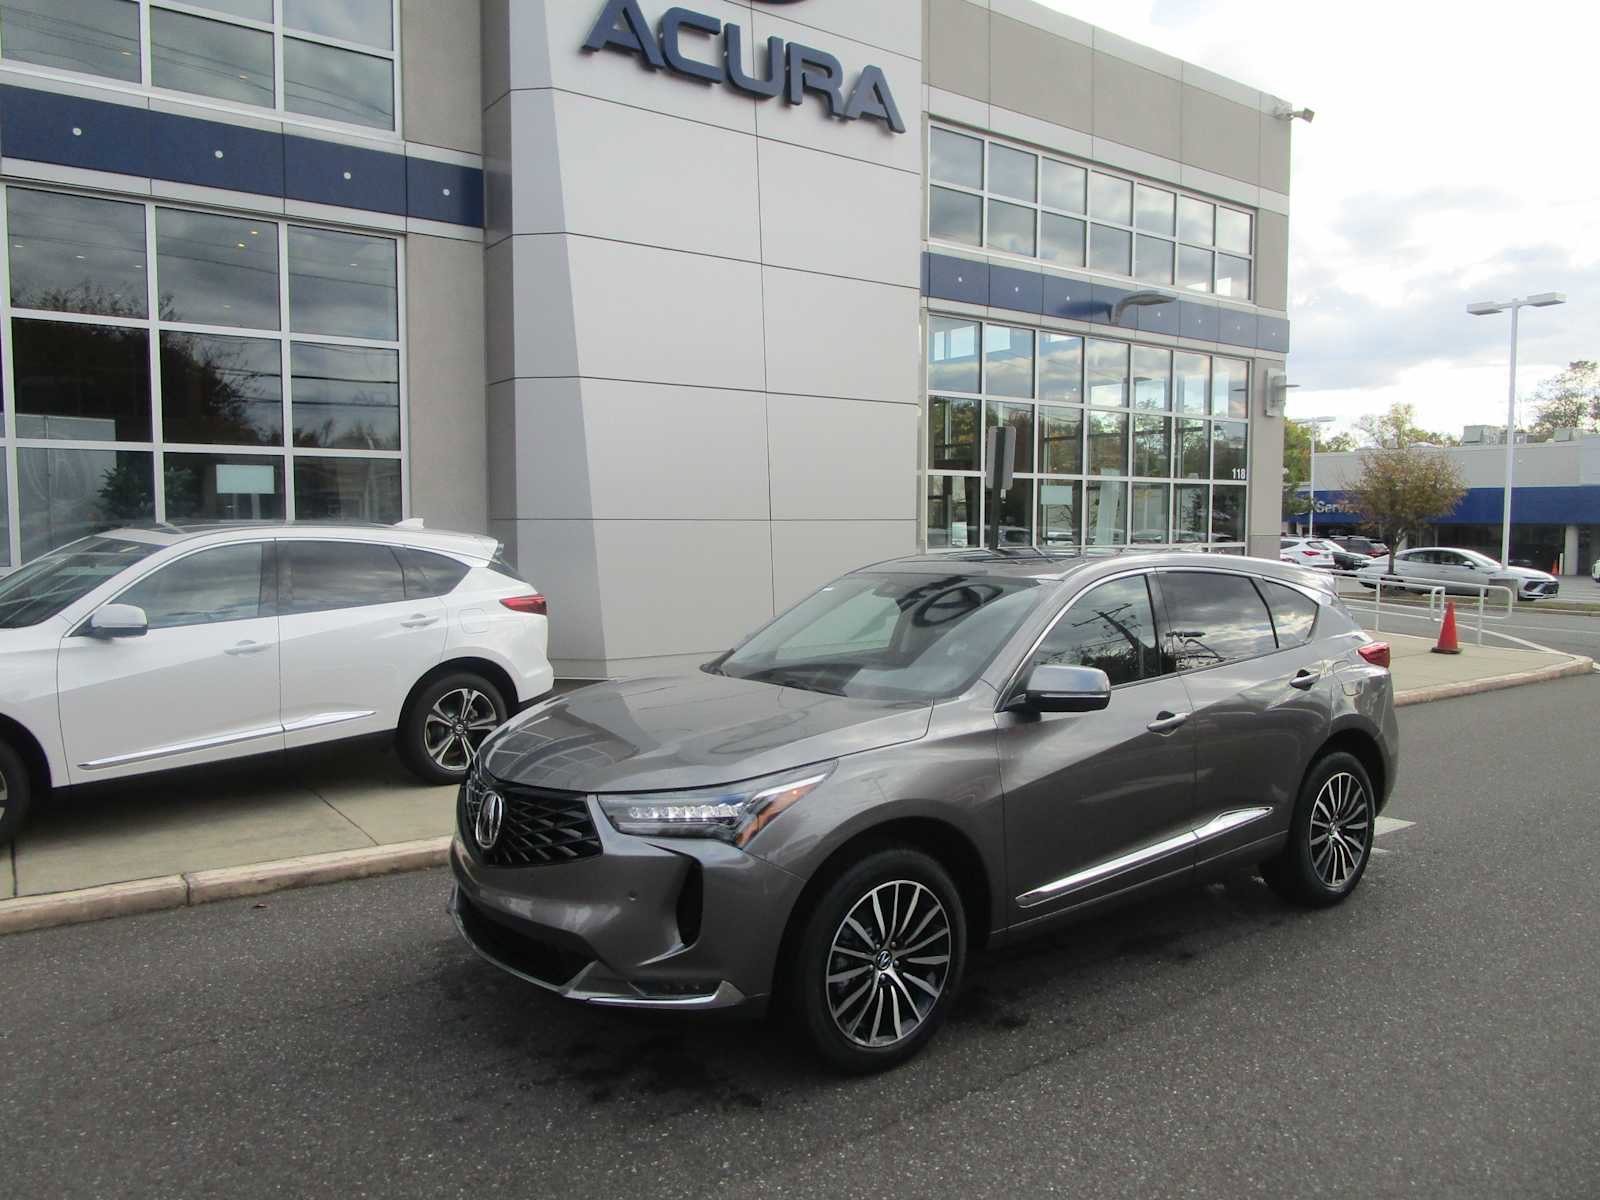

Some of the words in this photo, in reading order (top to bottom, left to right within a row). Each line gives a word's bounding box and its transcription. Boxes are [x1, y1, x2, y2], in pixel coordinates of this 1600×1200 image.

[582, 0, 906, 133] ACURA
[1232, 468, 1246, 479] 118
[1316, 500, 1361, 513] Servi
